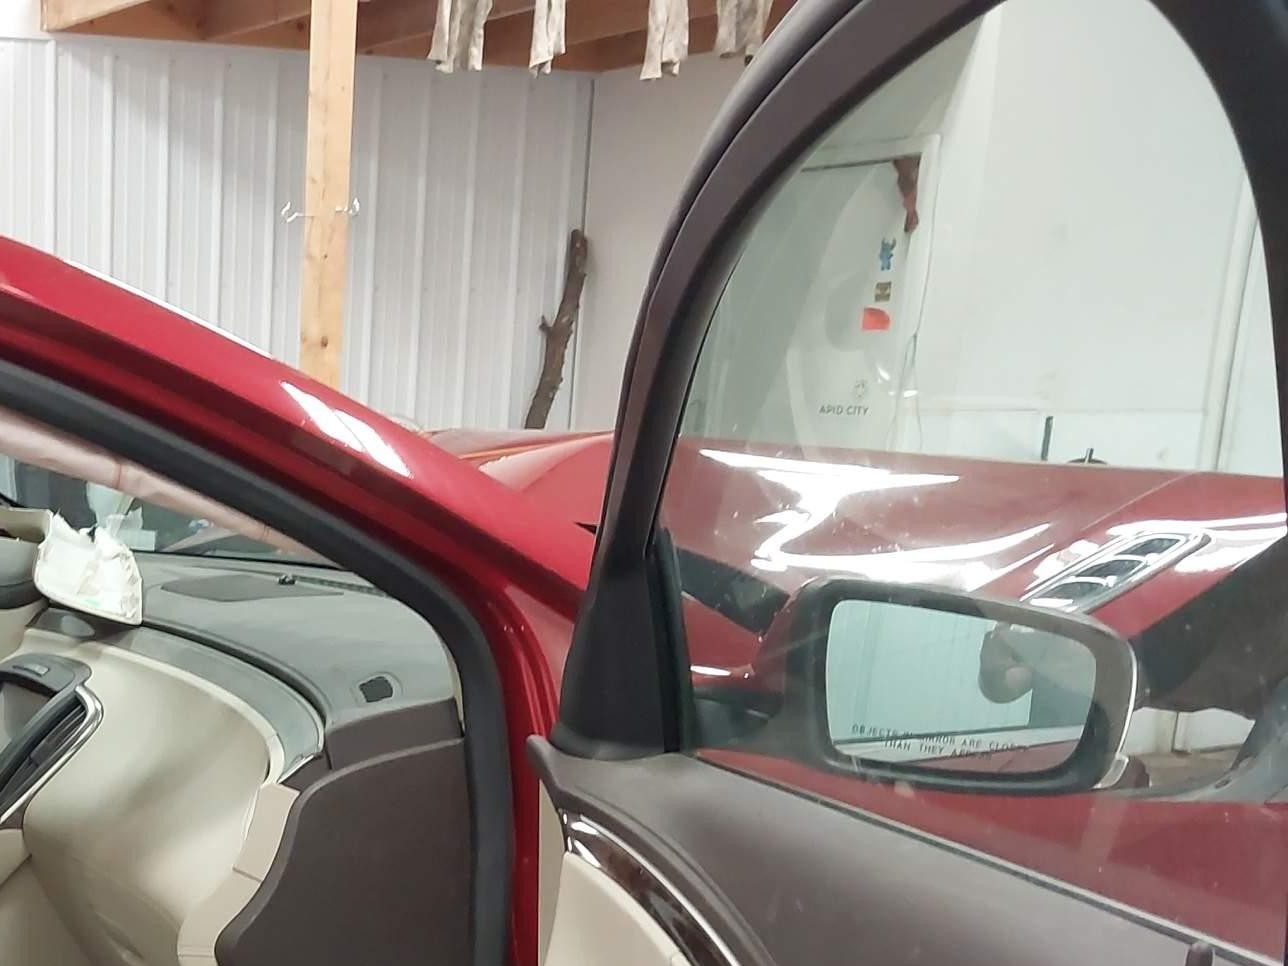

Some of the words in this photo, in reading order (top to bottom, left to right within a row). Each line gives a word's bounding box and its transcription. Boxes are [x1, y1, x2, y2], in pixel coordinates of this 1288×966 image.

[846, 405, 870, 416] CITY
[851, 723, 899, 738] OBJECTS
[884, 740, 912, 752] THAN
[919, 743, 944, 755] THEY
